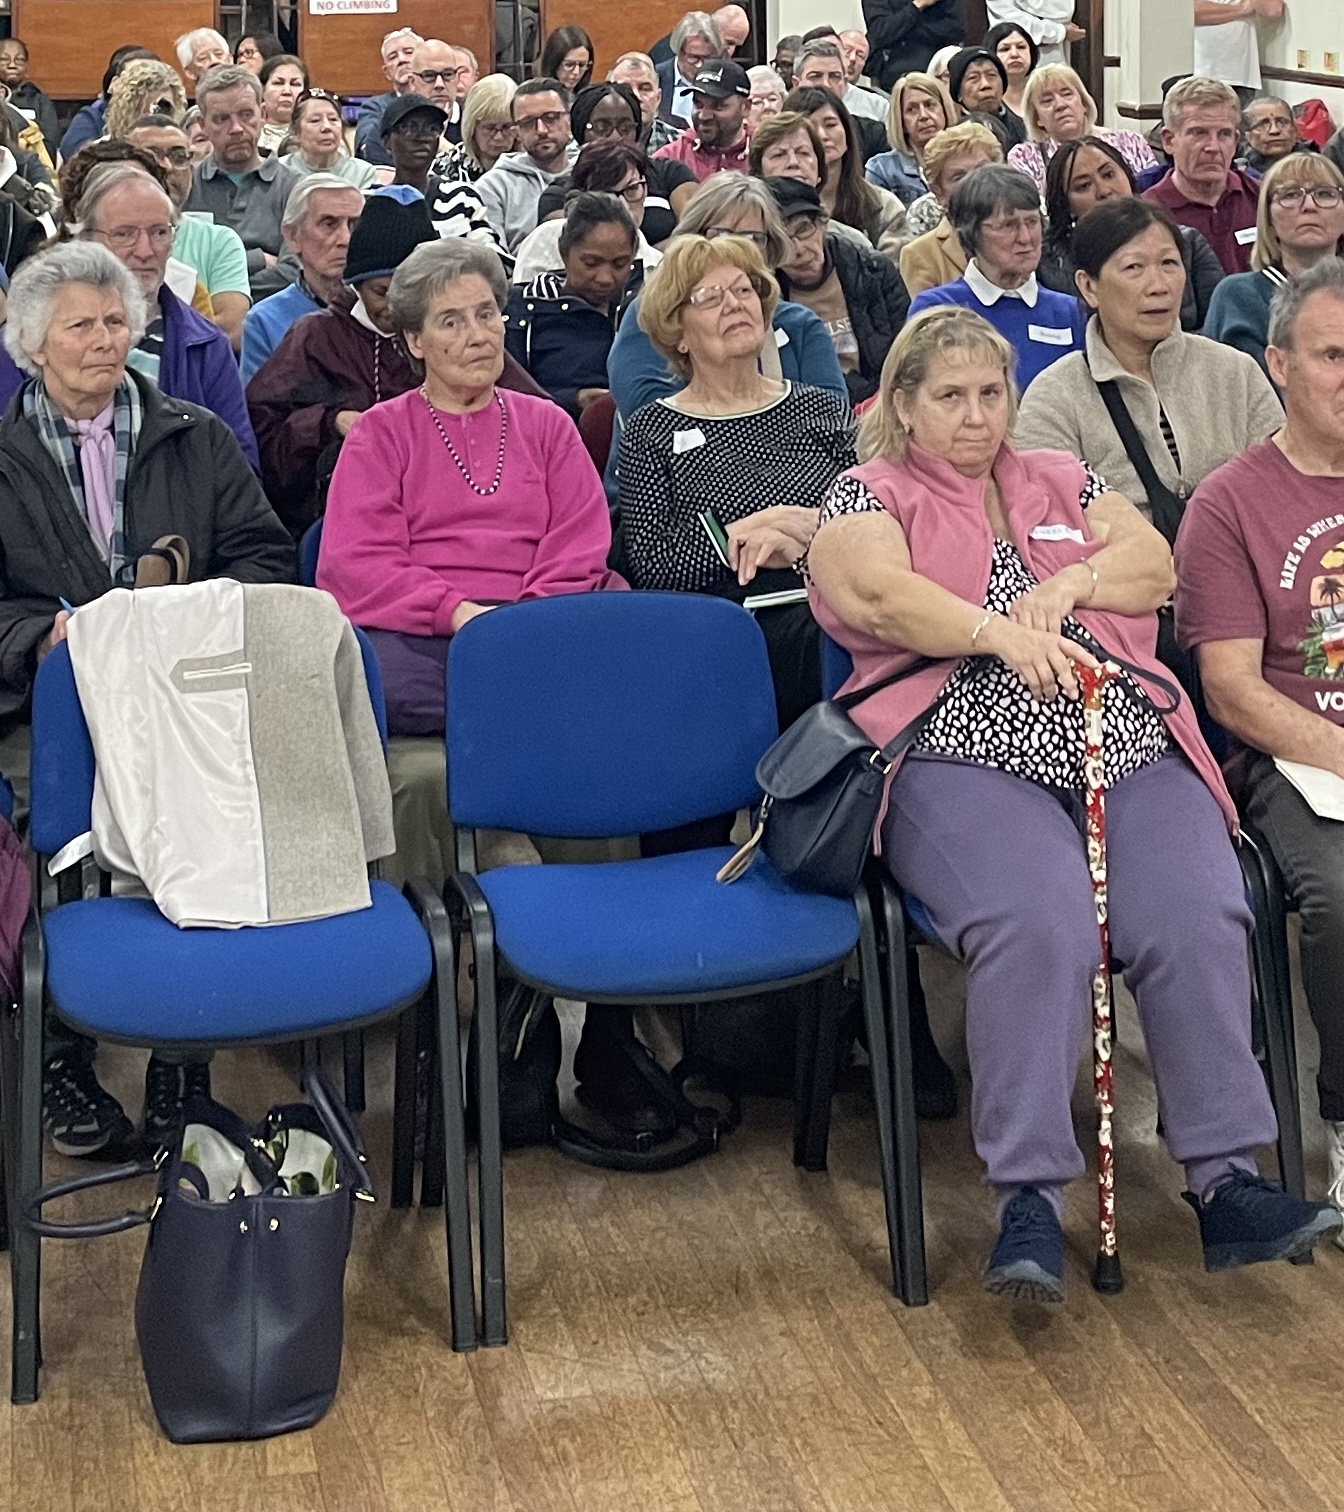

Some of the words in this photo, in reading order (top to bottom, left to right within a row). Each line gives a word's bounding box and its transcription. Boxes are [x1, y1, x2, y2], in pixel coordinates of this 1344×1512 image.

[316, 1, 334, 10] NO
[336, 0, 391, 10] CLIMBING
[1279, 551, 1302, 590] LIFE
[1293, 535, 1311, 554] IS
